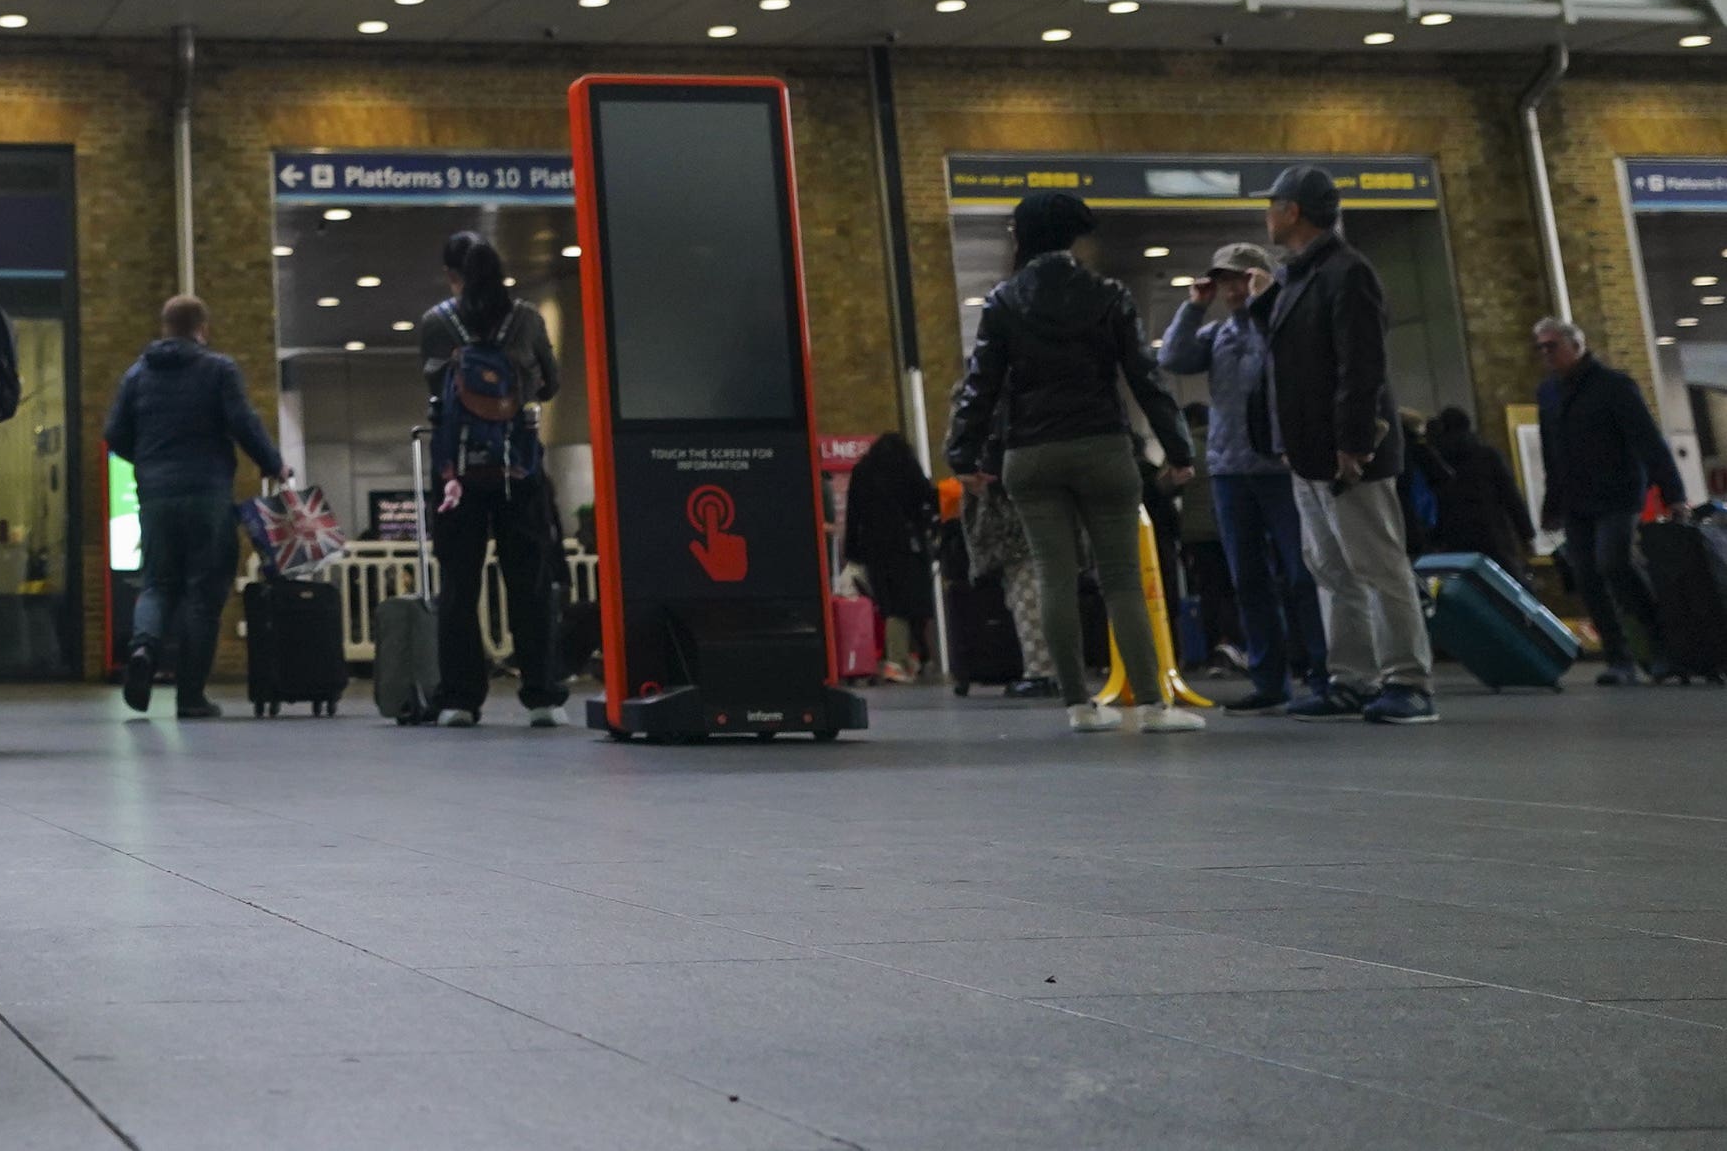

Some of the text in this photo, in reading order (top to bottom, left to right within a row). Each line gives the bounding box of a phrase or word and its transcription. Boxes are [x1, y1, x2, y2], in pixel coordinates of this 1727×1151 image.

[344, 166, 443, 188] Platforms
[447, 167, 461, 188] 9
[467, 169, 489, 188] to
[495, 168, 520, 187] 10
[651, 448, 773, 460] TOUCH THE SCREEN FOR
[677, 460, 749, 471] INFORMATION
